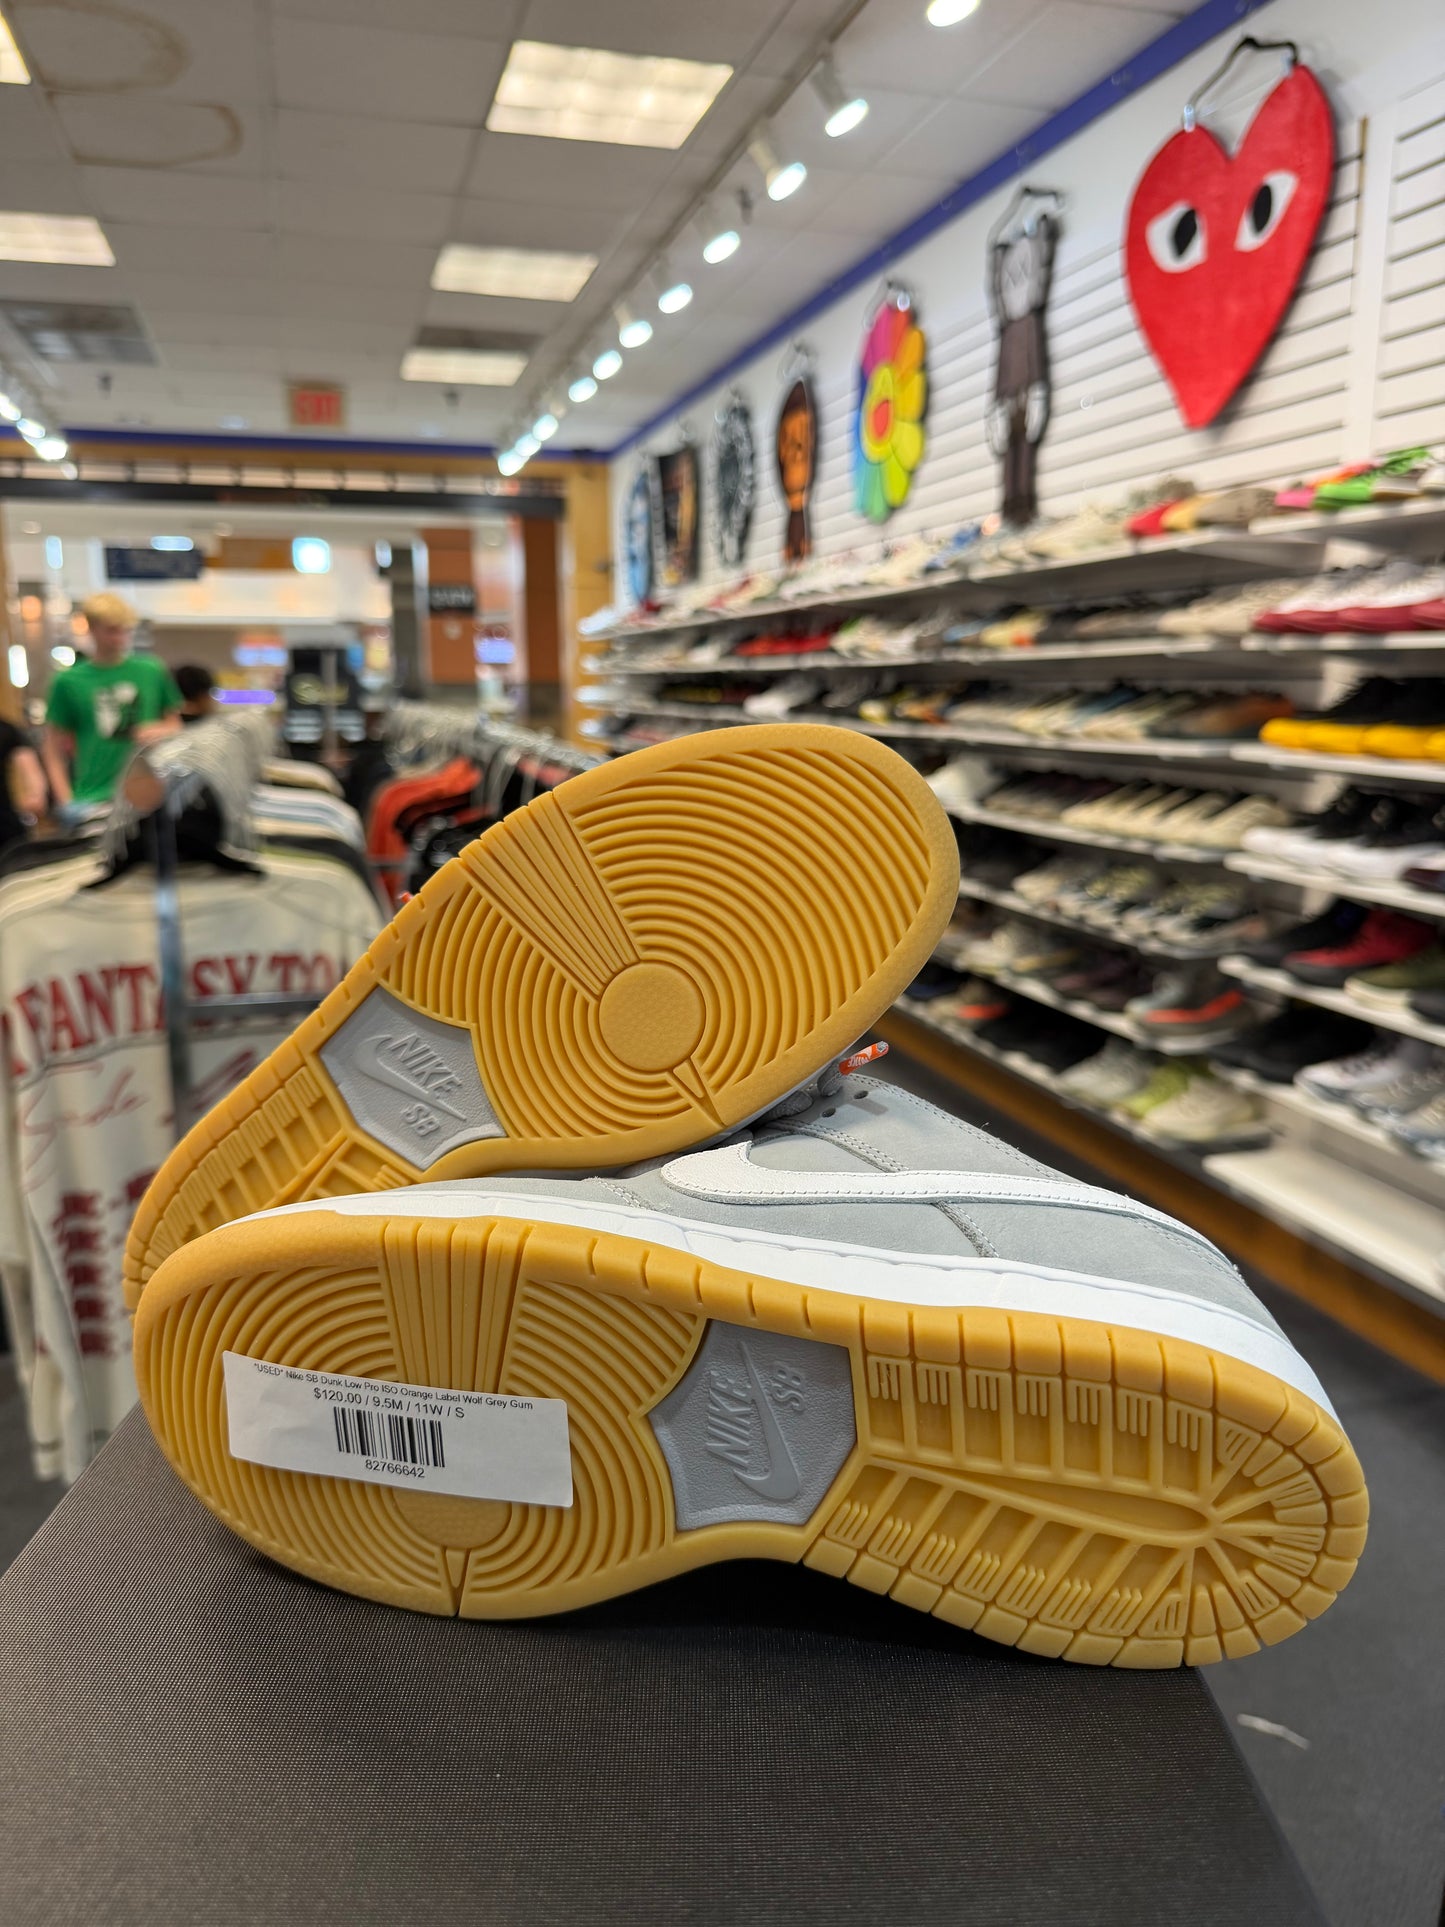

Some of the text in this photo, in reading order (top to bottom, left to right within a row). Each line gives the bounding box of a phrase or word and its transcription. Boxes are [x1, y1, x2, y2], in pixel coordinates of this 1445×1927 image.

[386, 1032, 462, 1099] NIKE
[401, 1103, 440, 1137] SB
[286, 1370, 304, 1381] Nike
[306, 1373, 319, 1383] SB
[321, 1375, 342, 1387] Dunk
[345, 1380, 362, 1390] Low
[365, 1382, 379, 1392] Pro
[382, 1385, 398, 1395] ISO
[401, 1387, 433, 1401] Orange
[436, 1392, 460, 1402] Label
[463, 1395, 483, 1404] Wolf
[485, 1397, 507, 1410] Grey
[510, 1400, 533, 1410] Gum
[314, 1387, 362, 1405] $120.00
[365, 1395, 370, 1406] /
[373, 1396, 403, 1411] 9.5M
[407, 1401, 411, 1412] /
[415, 1403, 442, 1416] 11W
[455, 1407, 465, 1419] S
[770, 1361, 806, 1414] SB
[704, 1370, 752, 1474] NIKE
[365, 1459, 425, 1478] 82766642
